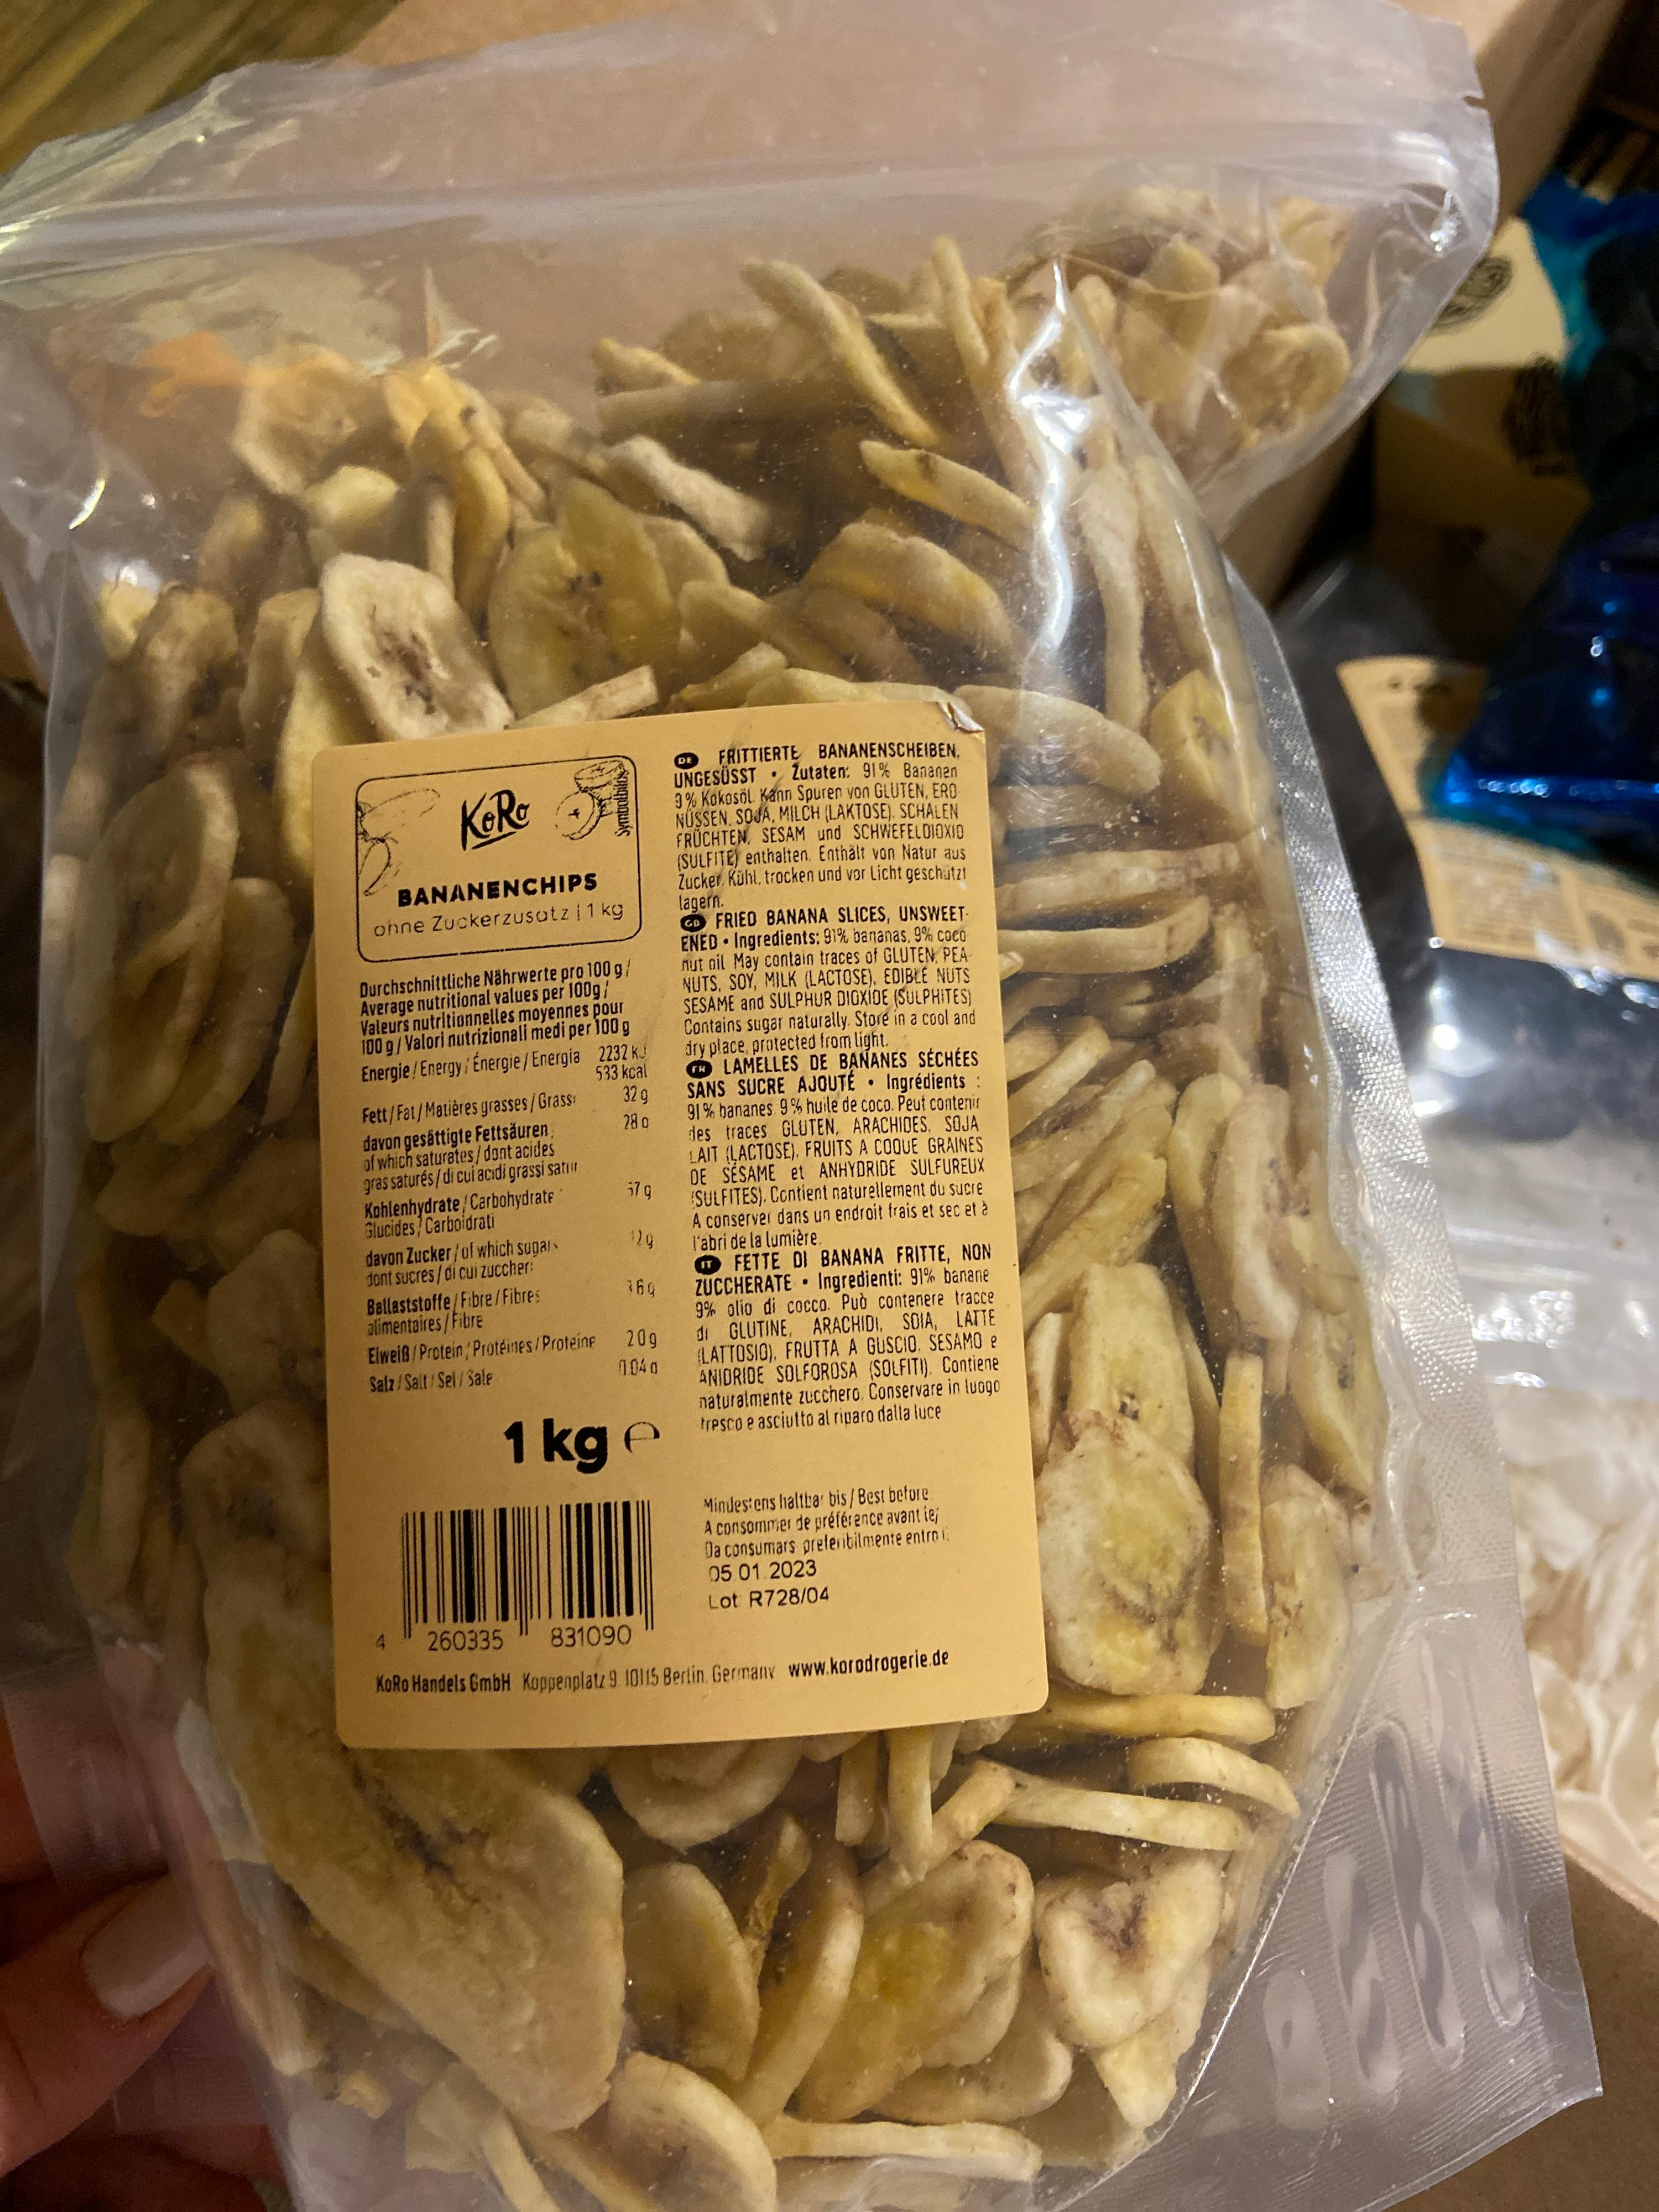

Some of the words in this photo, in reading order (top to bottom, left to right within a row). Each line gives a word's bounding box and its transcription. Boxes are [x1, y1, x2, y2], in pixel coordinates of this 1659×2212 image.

[675, 765, 756, 788] UNGESÜSST
[797, 785, 841, 803] Spuren
[461, 790, 530, 851] KoRo
[763, 826, 805, 843] SESAM
[818, 825, 841, 841] und
[818, 866, 841, 881] und
[871, 865, 901, 880] Licht
[398, 873, 597, 908] BANANENCHIPS
[432, 907, 568, 931] Zuckerzusatz
[602, 903, 623, 920] kg
[716, 911, 757, 929] FRIED
[767, 907, 828, 926] BANANA
[681, 934, 717, 952] ENED
[735, 930, 820, 951] Ingredients:
[734, 953, 758, 971] May
[765, 952, 813, 967] contain
[360, 973, 480, 998] Durchschnittliche
[484, 967, 556, 986] Nährwerte
[561, 967, 583, 983] pro
[587, 960, 611, 978] 100
[614, 964, 622, 979] g
[765, 971, 796, 988] MILK
[937, 967, 969, 983] NUTS
[361, 1000, 414, 1016] Average
[418, 989, 490, 1011] nutritional
[494, 987, 538, 1004] values
[543, 987, 564, 1004] per
[684, 995, 734, 1014] SESAME
[741, 995, 764, 1010] and
[770, 991, 832, 1009] SULPHUR
[361, 1020, 409, 1036] Valeurs
[413, 1008, 514, 1031] nutritionnelles
[519, 1005, 588, 1024] moyennes
[593, 1002, 623, 1021] pour
[685, 1017, 742, 1035] Contains
[747, 1018, 782, 1034] sugar
[911, 1014, 916, 1025] a
[922, 1009, 948, 1025] cool
[954, 1010, 975, 1025] and
[362, 1039, 382, 1055] 100
[386, 1040, 393, 1056] g
[405, 1031, 444, 1051] Valori
[448, 1024, 526, 1047] nutrizionali
[531, 1022, 565, 1040] medi
[569, 1024, 591, 1040] per
[594, 1019, 618, 1035] 100
[623, 1021, 629, 1036] g
[753, 1034, 815, 1055] protected
[599, 1044, 627, 1062] 2232
[724, 1055, 798, 1074] LAMELLES
[839, 1052, 907, 1070] BANANES
[919, 1047, 978, 1067] SÉCHÉES
[362, 1065, 409, 1083] Energie
[473, 1052, 520, 1073] Énergie
[533, 1051, 580, 1068] Energia
[596, 1065, 618, 1081] 533
[622, 1064, 647, 1079] kcal
[624, 1086, 637, 1102] 32
[641, 1089, 648, 1104] g
[687, 1081, 725, 1098] SANS
[738, 1077, 785, 1095] SUCRE
[798, 1070, 855, 1093] AJOUTÉ
[862, 1099, 893, 1112] coco.
[898, 1095, 925, 1111] Peut
[362, 1108, 387, 1124] Fett
[364, 1135, 400, 1152] davon
[404, 1128, 472, 1154] gesättigte
[476, 1123, 547, 1142] Fettsäuren
[806, 1140, 852, 1157] FRUITS
[860, 1139, 868, 1155] A
[723, 1162, 775, 1183] SÉSAME
[771, 1185, 827, 1202] Contient
[693, 1213, 701, 1228] A
[836, 1203, 882, 1222] endroit
[750, 1232, 761, 1248] la
[366, 1251, 403, 1267] davon
[406, 1245, 451, 1264] Zucker
[701, 1260, 713, 1269] IT
[735, 1252, 780, 1271] FETTE
[794, 1251, 807, 1268] DI
[821, 1248, 884, 1267] BANANA
[962, 1244, 990, 1260] NON
[696, 1274, 791, 1296] ZUCCHERATE
[818, 1269, 901, 1293] Ingredienti:
[944, 1267, 988, 1284] banane
[367, 1293, 450, 1317] Ballaststoffe
[728, 1300, 752, 1317] olio
[764, 1298, 775, 1315] di
[842, 1293, 867, 1310] Può
[879, 1293, 943, 1309] contenere
[956, 1291, 994, 1305] tracce
[957, 1309, 995, 1327] LATTE
[786, 1339, 839, 1359] FRUTTA
[849, 1338, 857, 1355] A
[930, 1332, 982, 1351] SESAMO
[991, 1335, 997, 1348] e
[370, 1375, 394, 1392] Salz
[700, 1390, 792, 1409] naturalmente
[869, 1383, 942, 1400] Conservare
[949, 1383, 959, 1394] in
[966, 1379, 999, 1396] luogo
[759, 1411, 813, 1429] asciutto
[878, 1405, 910, 1422] dalla
[543, 1418, 608, 1474] kg
[705, 1520, 712, 1534] A
[888, 1509, 920, 1524] avant
[750, 1587, 828, 1607] R728/04
[377, 1634, 385, 1649] 4
[429, 1629, 503, 1651] 260335
[551, 1625, 631, 1647] 831090
[376, 1673, 409, 1693] KoRo
[413, 1674, 466, 1692] Handels
[469, 1673, 510, 1692] GmbH
